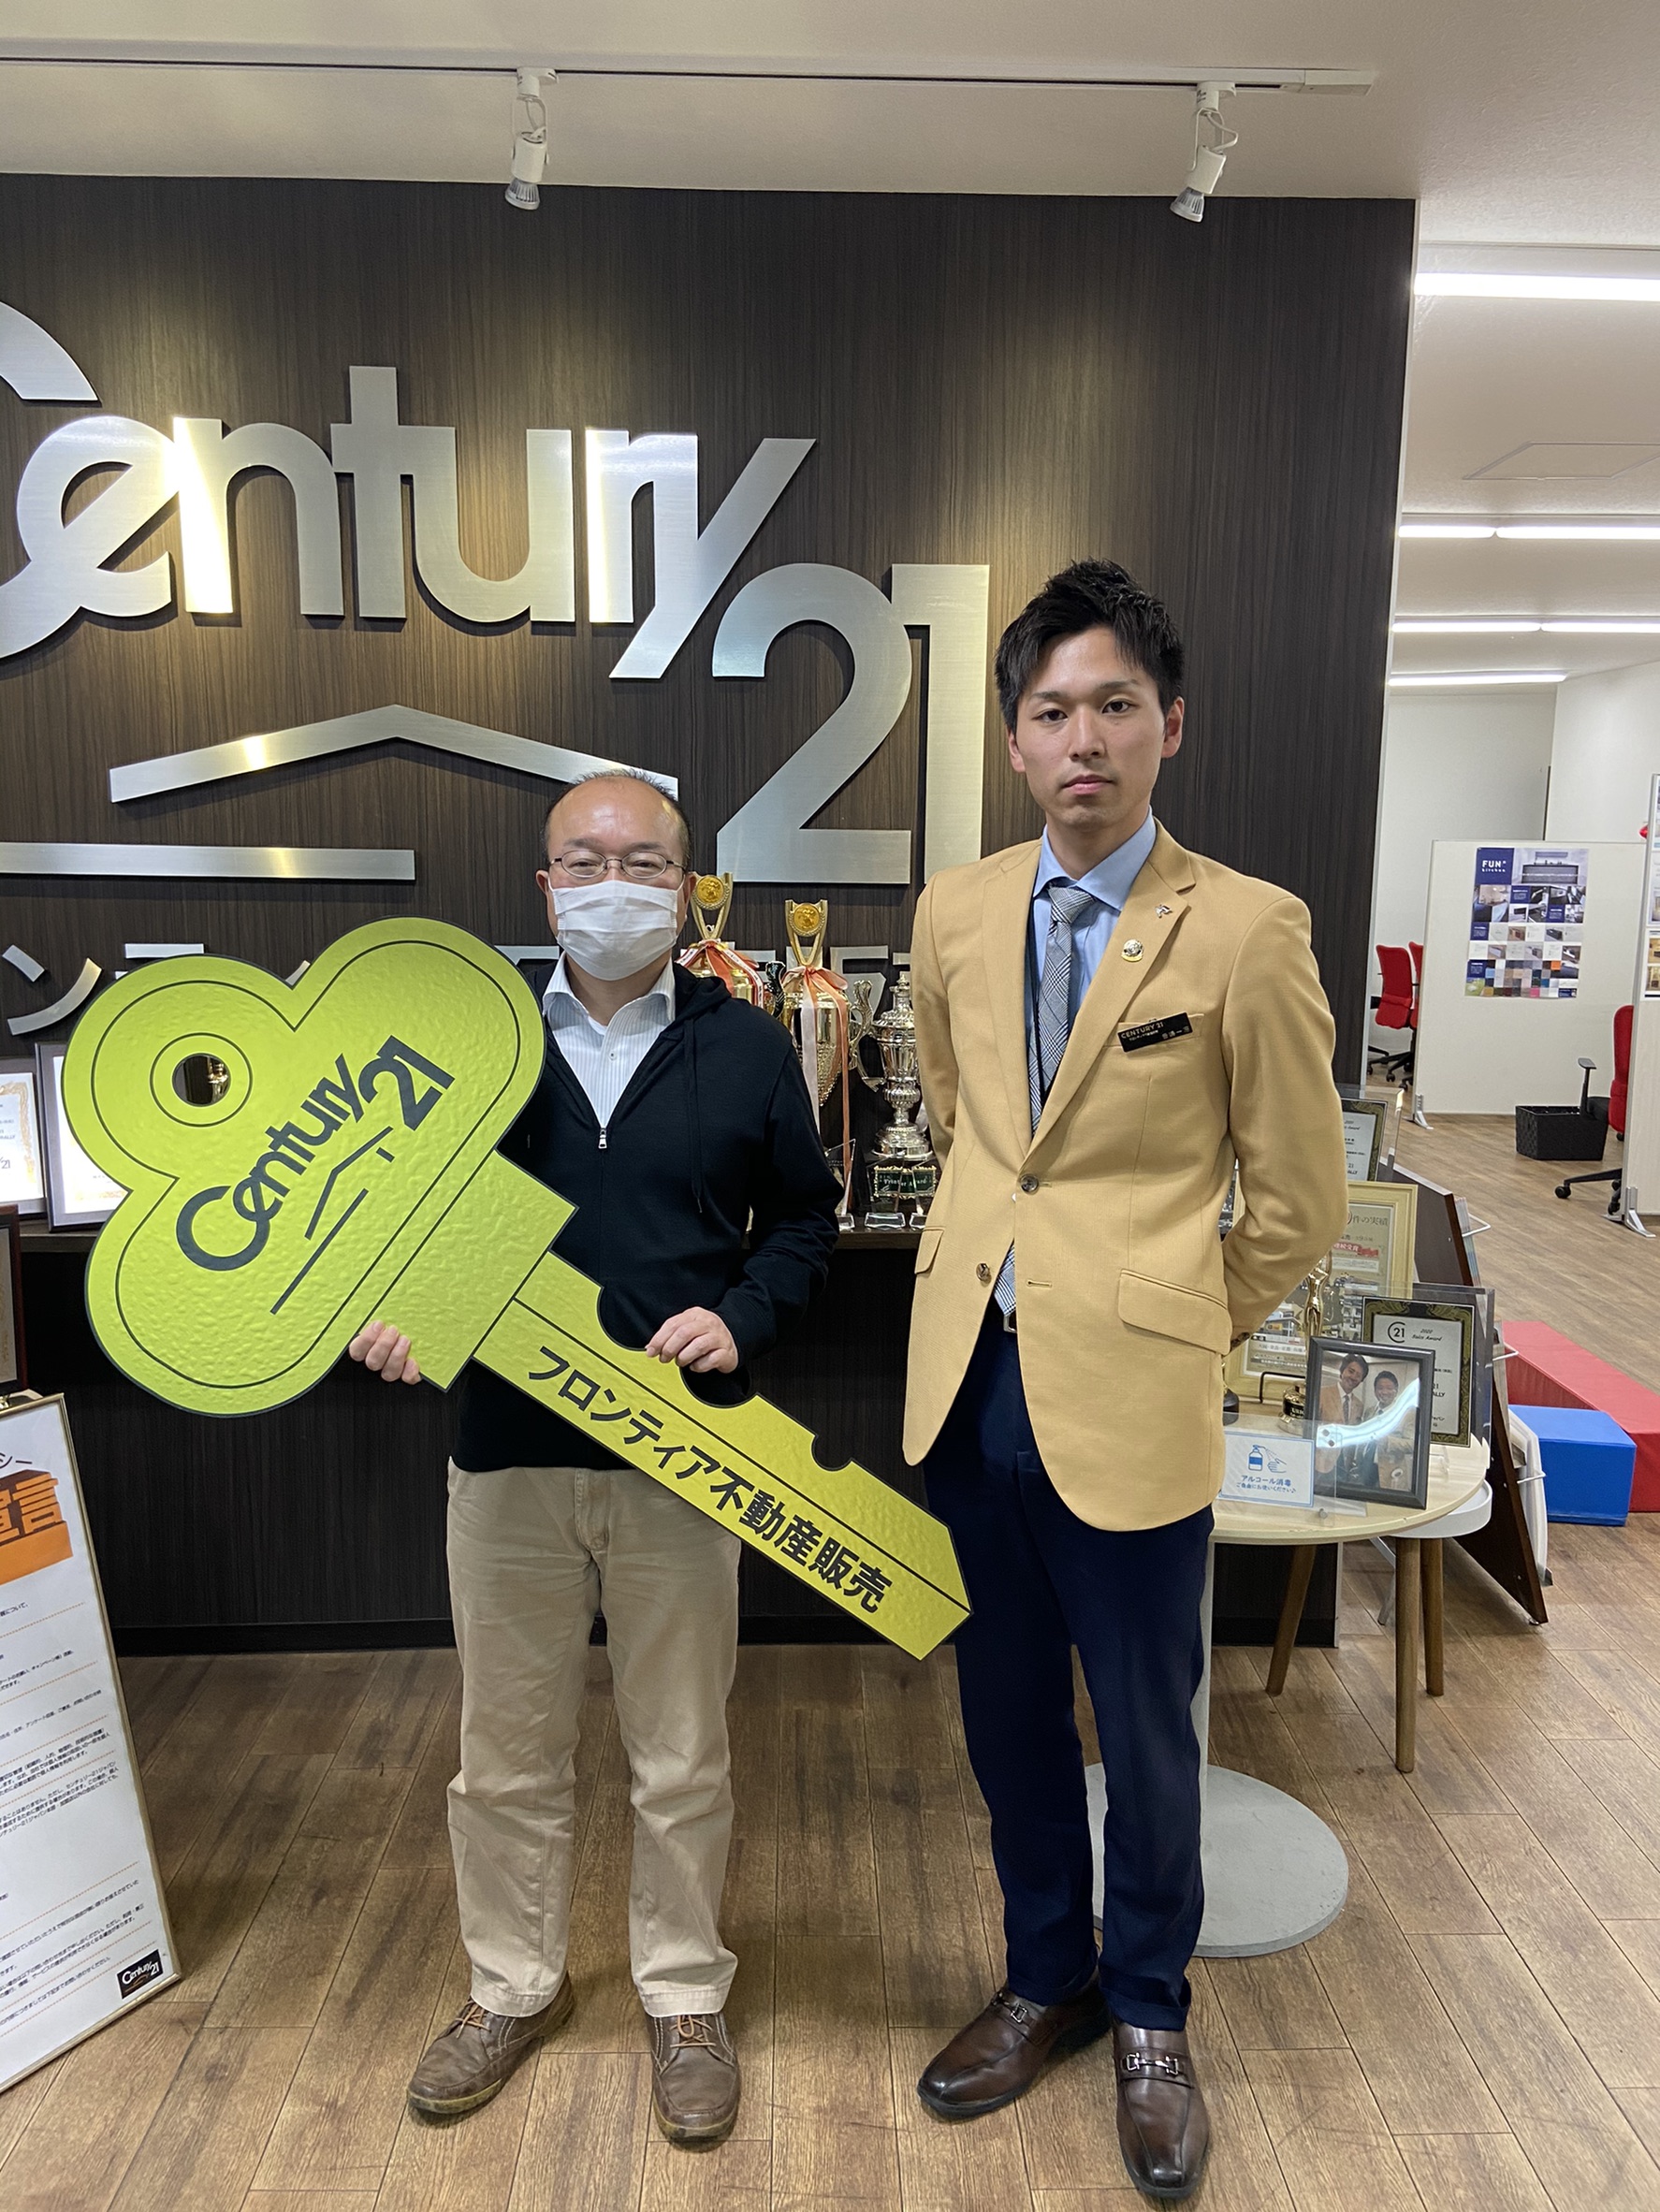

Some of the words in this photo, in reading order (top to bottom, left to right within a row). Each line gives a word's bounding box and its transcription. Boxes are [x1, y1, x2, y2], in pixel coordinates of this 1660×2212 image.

[712, 562, 989, 883] 21
[1121, 1023, 1156, 1039] CENTURY
[1156, 1021, 1164, 1029] 21
[176, 1053, 365, 1272] Century
[357, 1035, 456, 1131] 21
[529, 1346, 893, 1614] フロンティア不動産販売
[1241, 1475, 1291, 1487] アルコール消毒
[150, 1961, 160, 1975] 21
